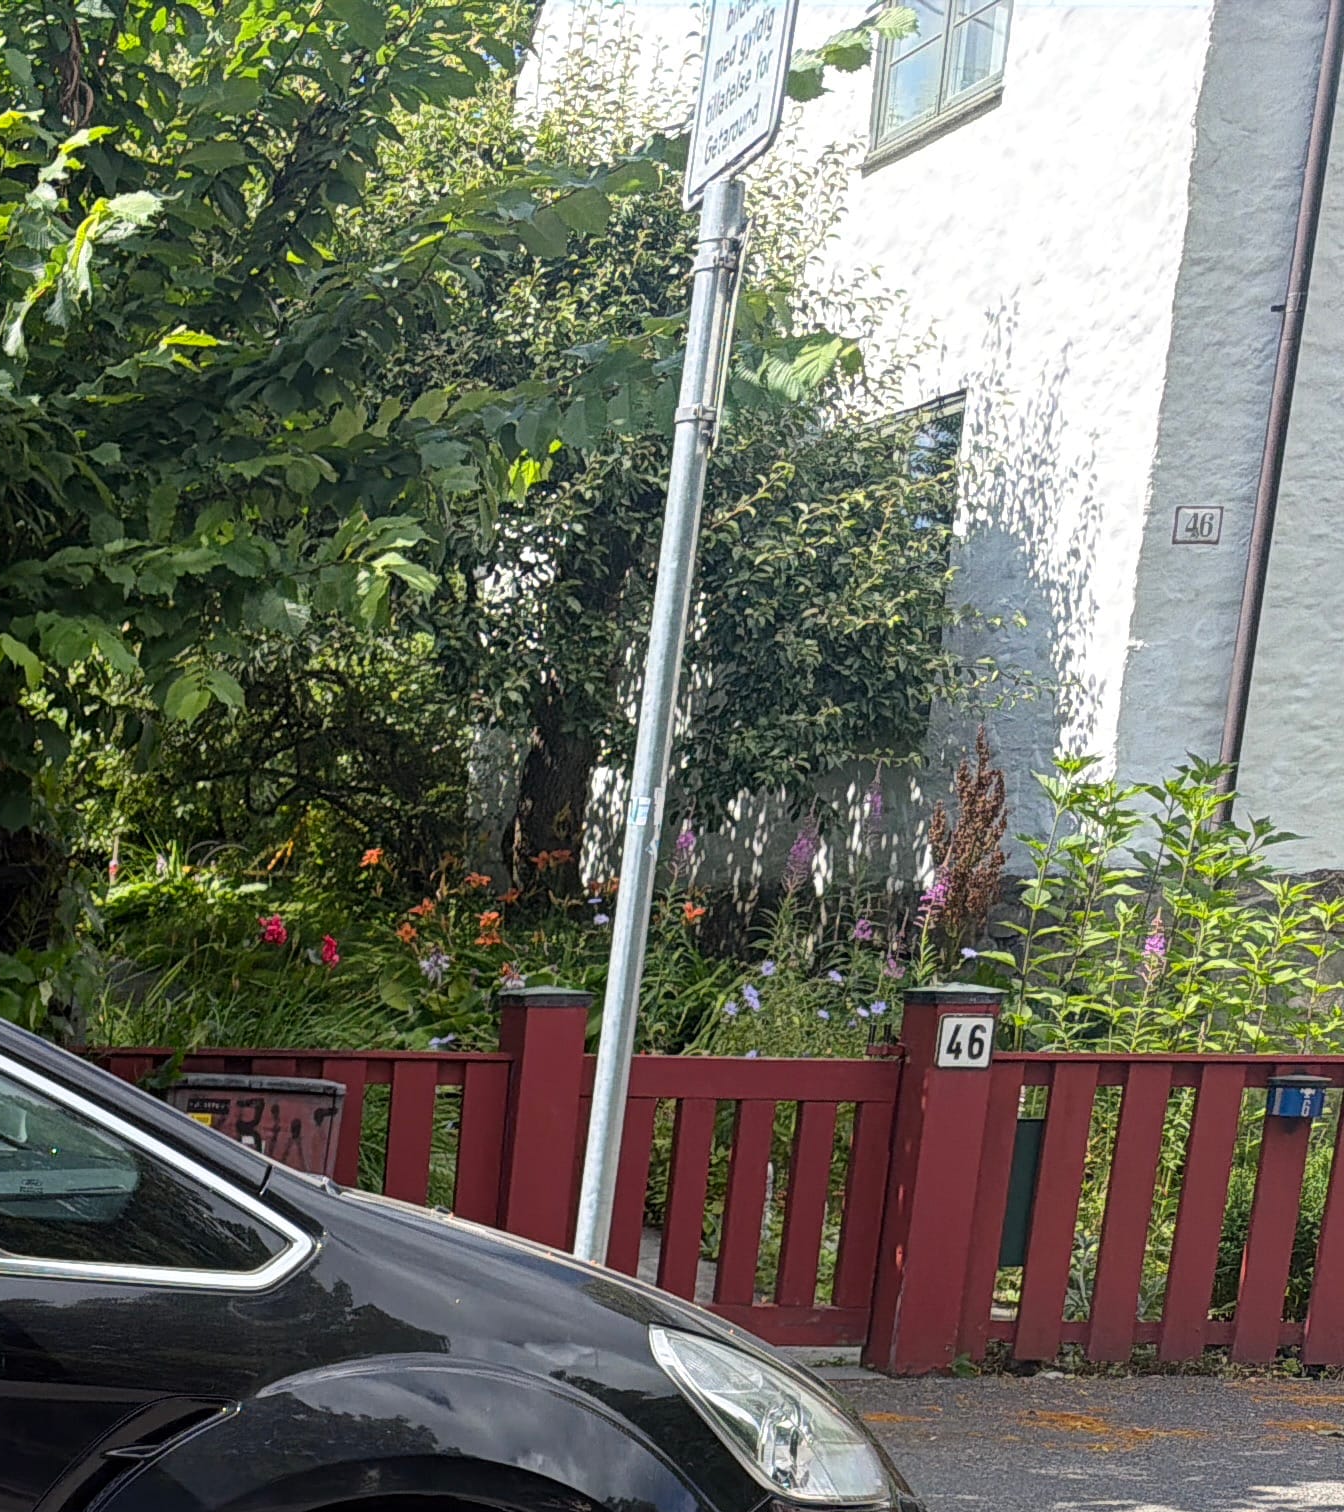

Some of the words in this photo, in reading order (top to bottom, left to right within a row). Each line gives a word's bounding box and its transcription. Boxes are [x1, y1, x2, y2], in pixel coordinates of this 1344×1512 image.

[713, 35, 738, 82] med
[739, 5, 775, 66] gyldig
[755, 49, 773, 83] for
[704, 92, 761, 165] Getaround
[1185, 513, 1214, 538] 46
[946, 1024, 987, 1060] 46
